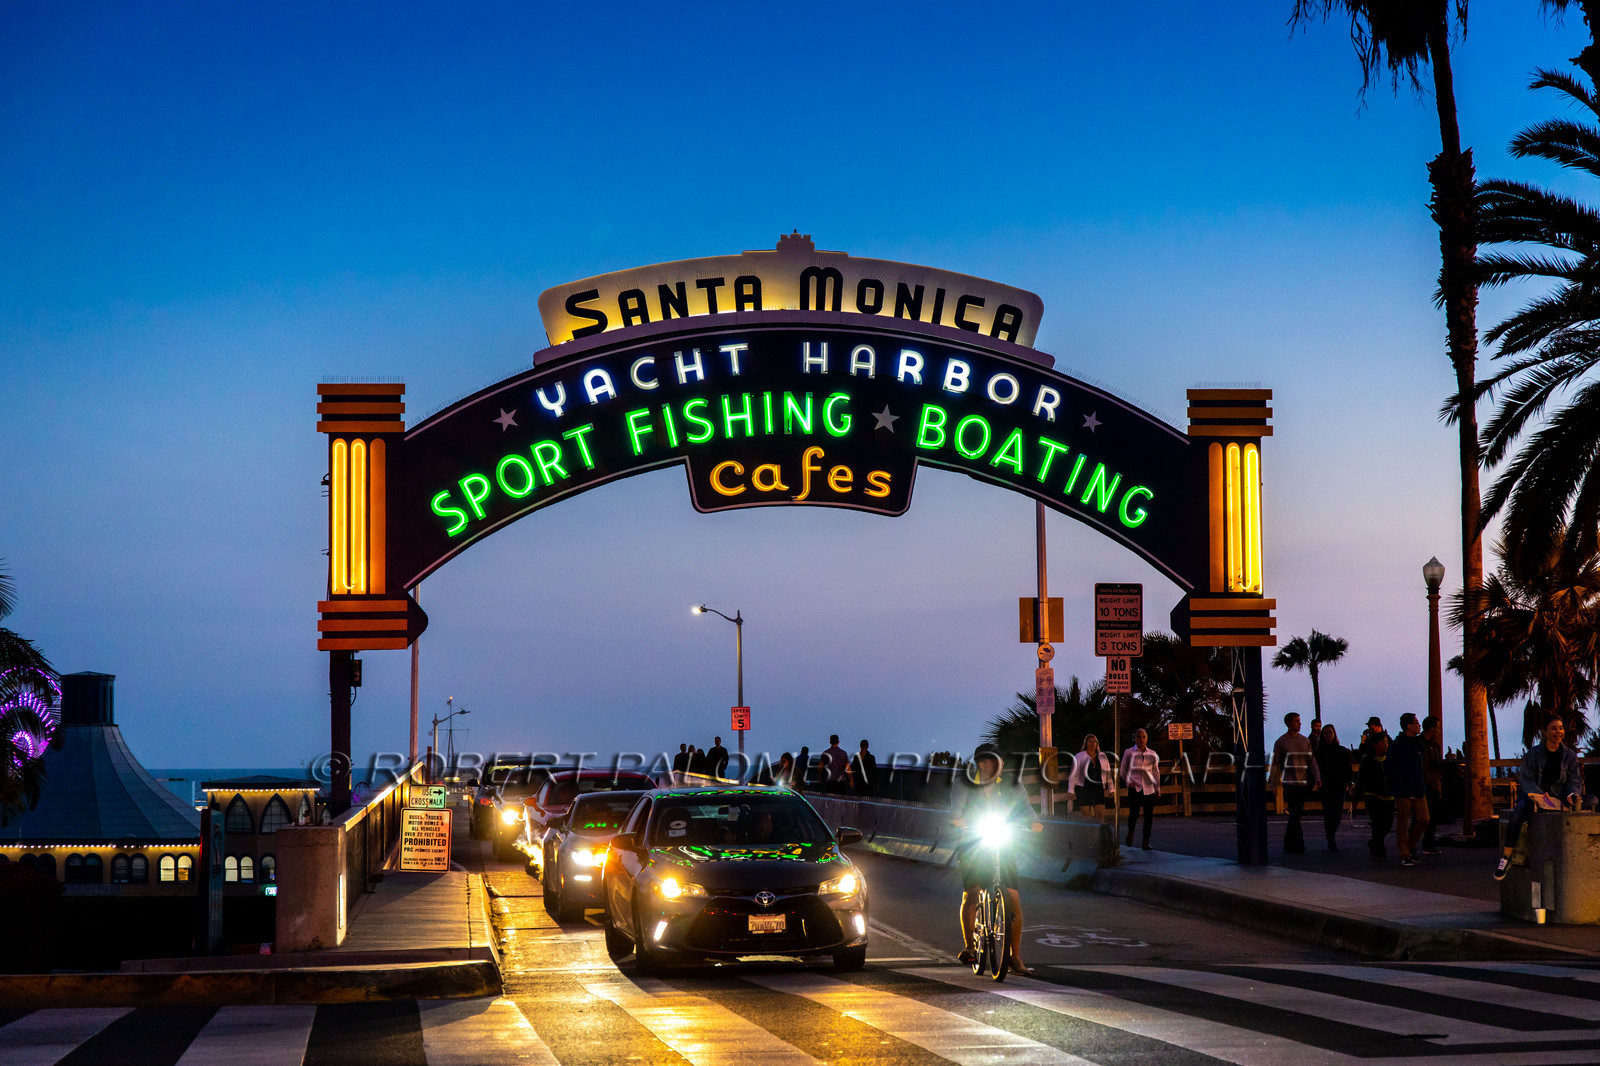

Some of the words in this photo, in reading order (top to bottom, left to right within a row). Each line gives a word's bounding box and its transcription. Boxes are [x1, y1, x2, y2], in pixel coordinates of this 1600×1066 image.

[564, 274, 762, 340] SANTA
[799, 265, 1023, 344] MONICA
[536, 342, 749, 418] YACHT
[802, 341, 1061, 422] HARBOR
[430, 422, 595, 538] SPORT
[624, 391, 853, 456] FISHING
[916, 403, 1155, 529] BOATING
[1099, 607, 1110, 617] 10
[1113, 607, 1138, 617] TONS
[1100, 641, 1107, 651] 3
[1110, 641, 1137, 651] TONS
[1111, 659, 1126, 671] NO
[738, 719, 745, 728] 5
[411, 798, 443, 806] CROSSWALK
[404, 837, 447, 847] PROHIBITED
